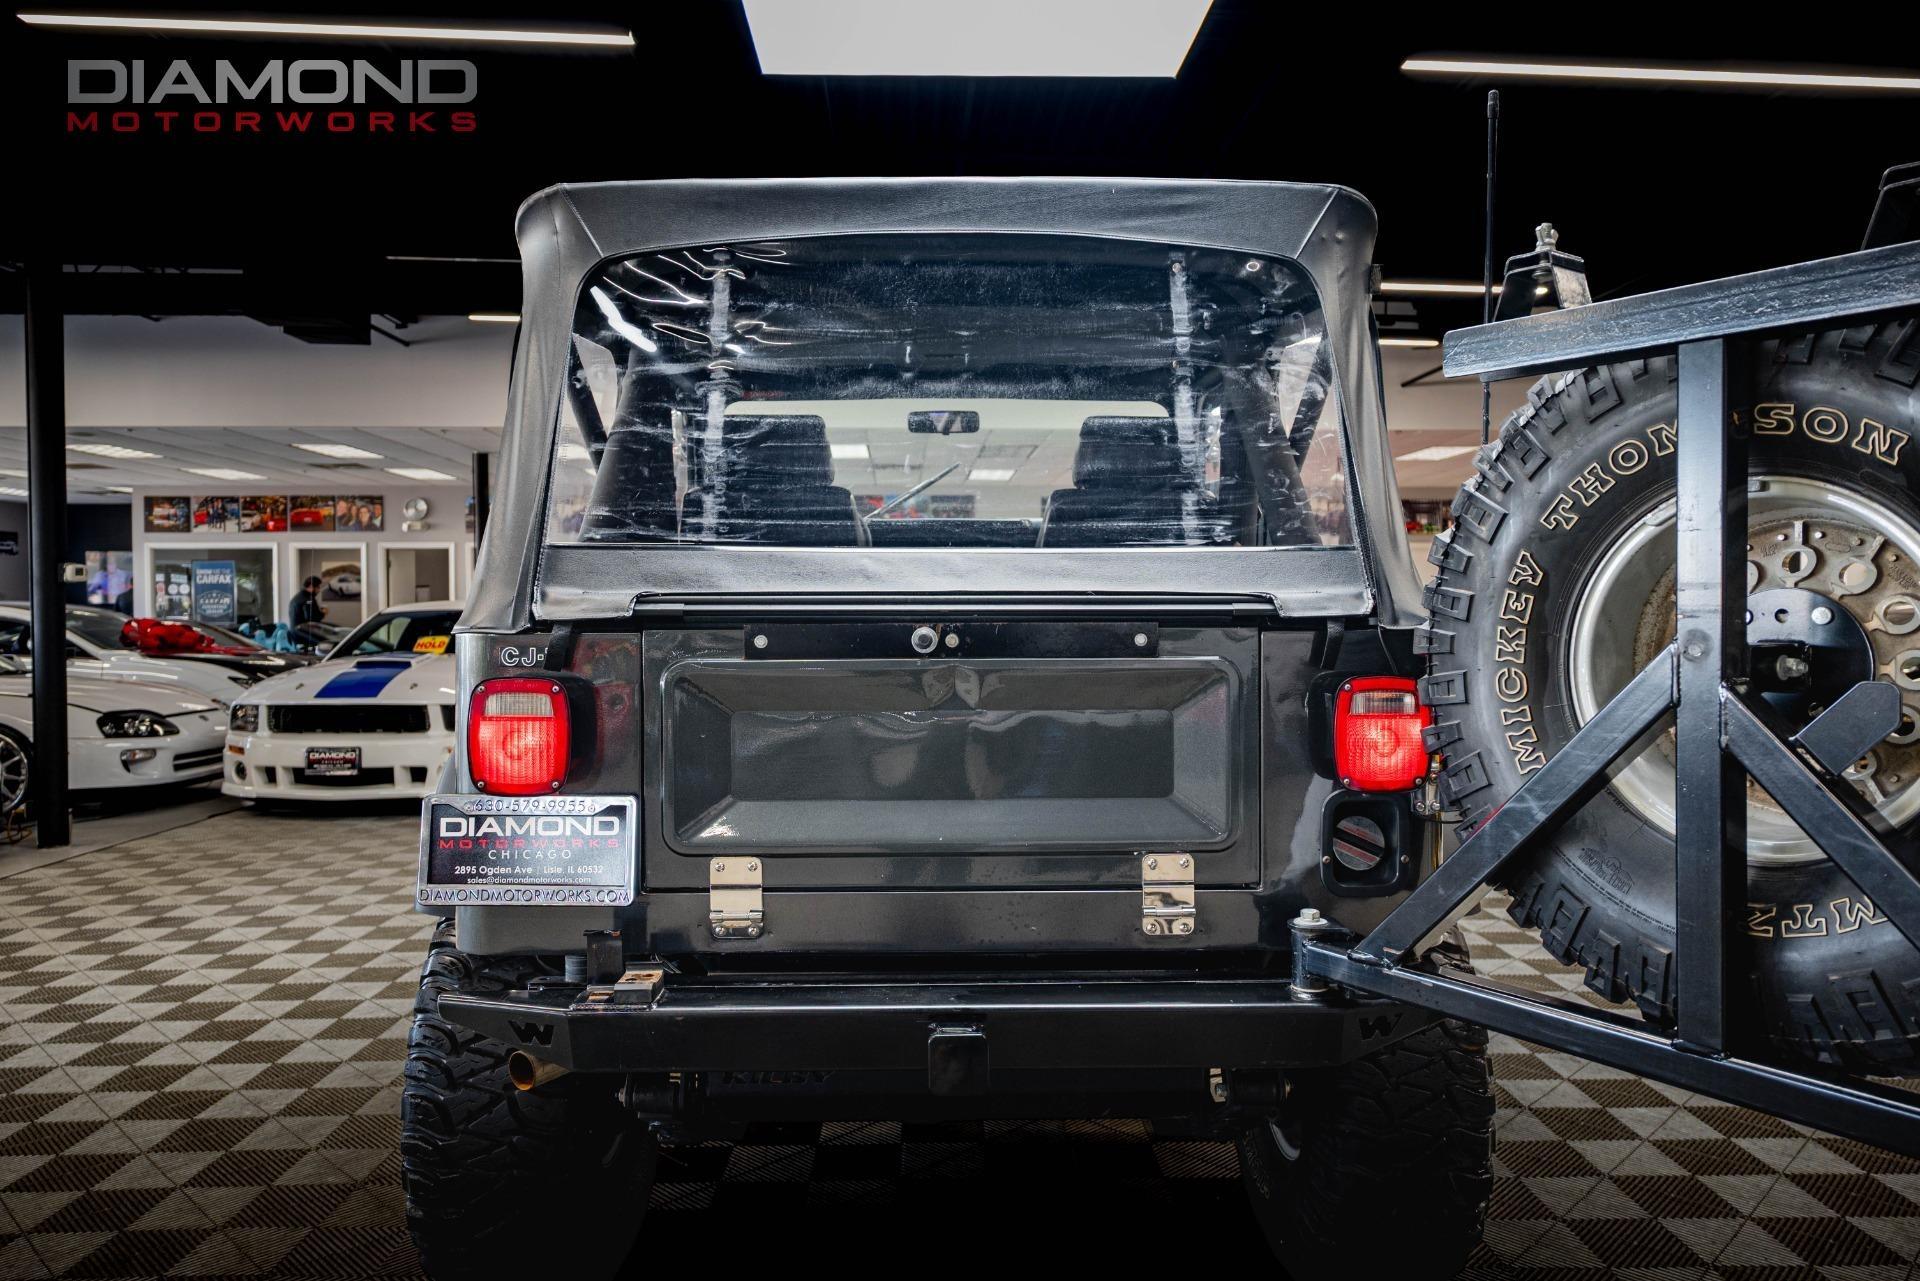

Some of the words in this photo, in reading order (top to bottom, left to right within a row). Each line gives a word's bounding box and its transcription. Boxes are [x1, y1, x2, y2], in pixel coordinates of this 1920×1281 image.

[1496, 550, 1548, 775] MICKEY
[1541, 403, 1910, 531] THOMSON
[501, 646, 549, 667] CJ-
[475, 799, 585, 812] 630-579-9955
[440, 816, 620, 837] DIAMOND
[439, 837, 619, 849] MOTORWORKS
[488, 849, 572, 860] CHICAGO
[454, 865, 477, 875] 2895
[479, 865, 512, 876] Ogden
[514, 865, 533, 874] Ave
[567, 865, 575, 874] IL
[577, 865, 603, 874] 60532
[467, 876, 592, 885] sales@diamondmotorworks.com
[420, 888, 631, 903] DIAMONDMOTORWORKS.COM
